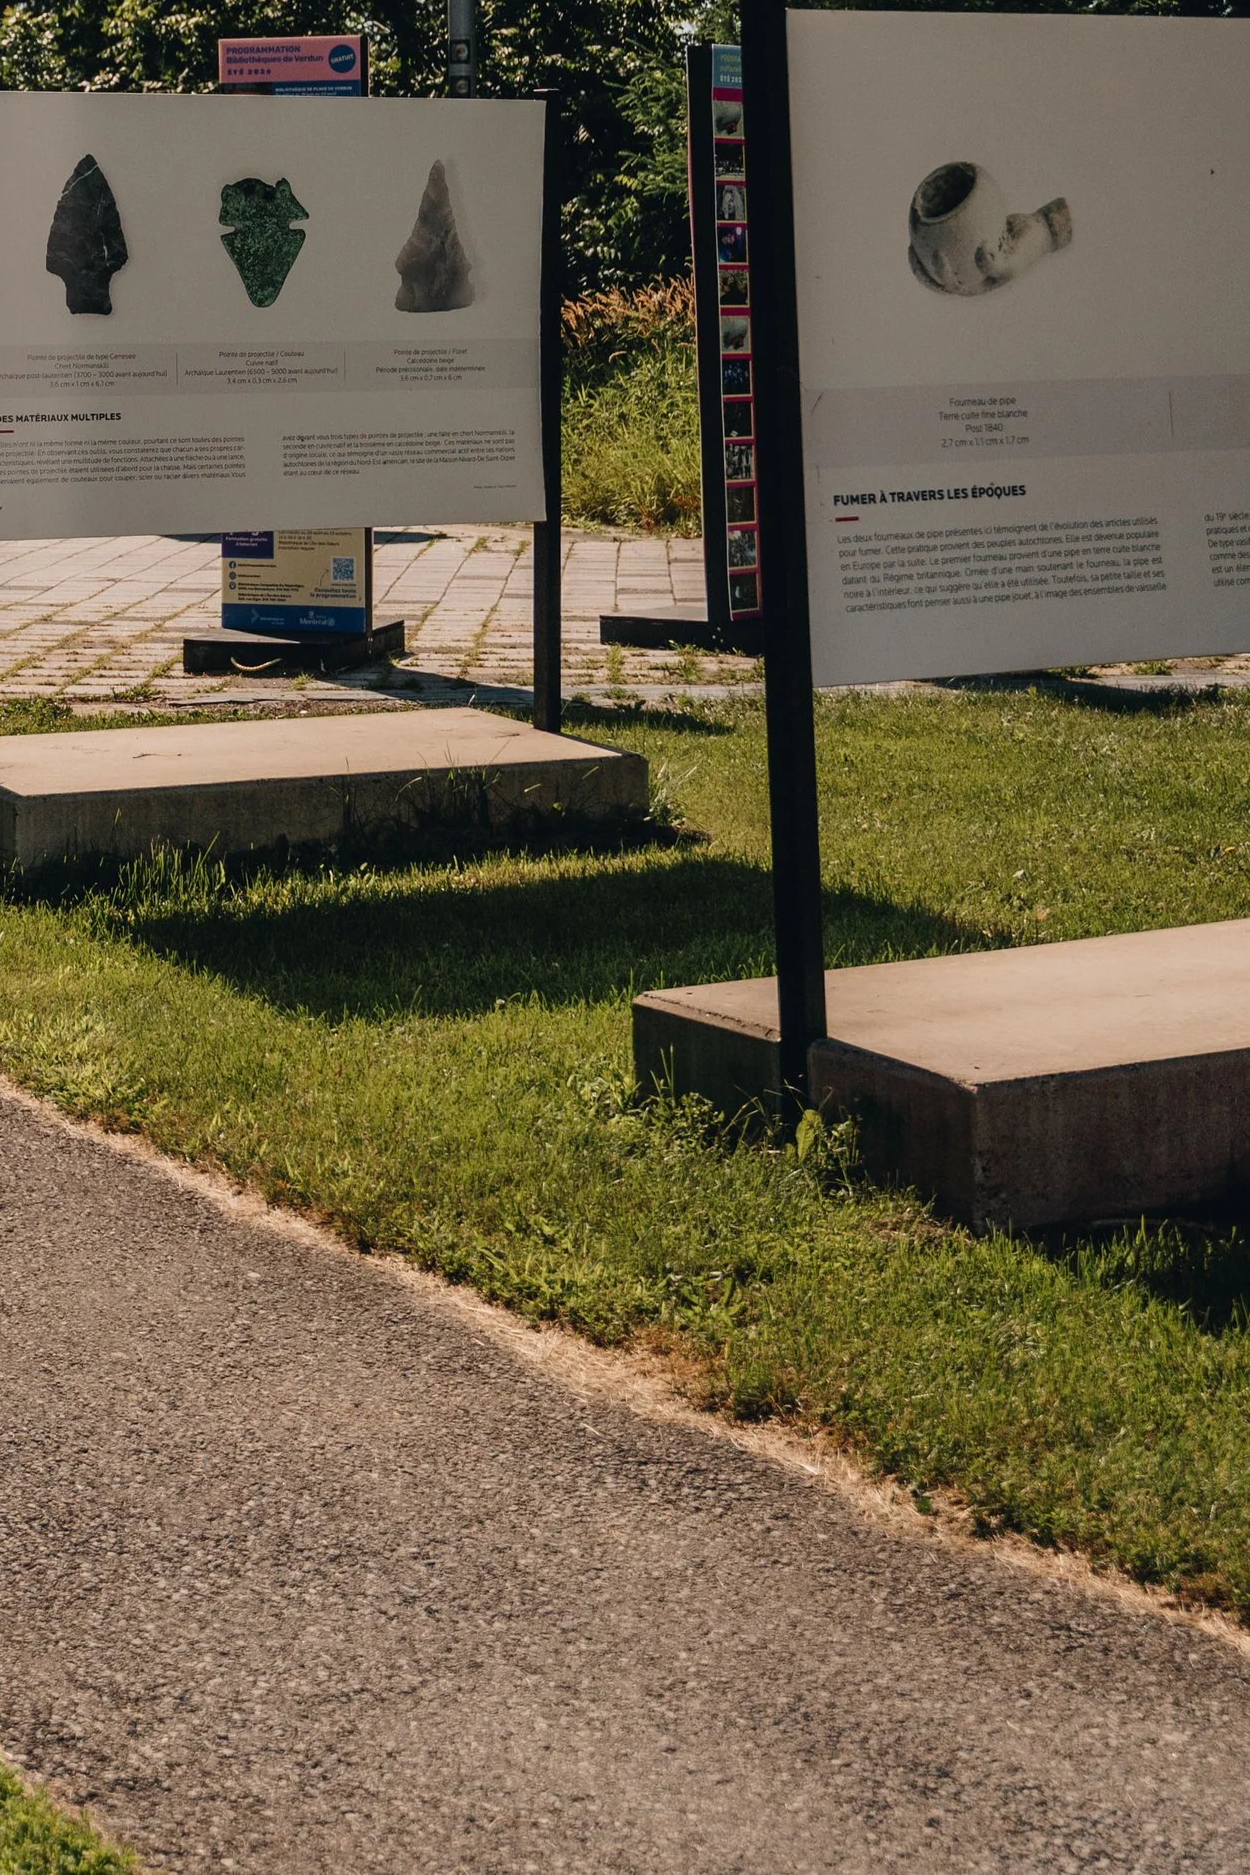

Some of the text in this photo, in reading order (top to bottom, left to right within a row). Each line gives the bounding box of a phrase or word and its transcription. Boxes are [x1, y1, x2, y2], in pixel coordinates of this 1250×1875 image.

[226, 45, 301, 55] PROGRAMMATION
[226, 54, 324, 64] Bibliothèques de Verdun
[330, 53, 354, 64] GRATUIT
[949, 397, 1016, 407] Fourneau de pipe
[16, 413, 69, 422] MATÉRIAUX
[71, 412, 122, 422] MULTIPLES
[938, 409, 1028, 421] Terre cuite fine blanche
[965, 423, 1003, 433] Post 1840
[954, 439, 966, 447] cm
[985, 438, 998, 446] cm
[1017, 437, 1029, 445] cm
[833, 493, 876, 507] FUMER
[879, 490, 887, 503] À
[889, 489, 944, 503] TRAVERS
[947, 487, 968, 499] LES
[836, 533, 852, 544] Les
[852, 532, 872, 543] deux
[874, 530, 914, 541] fourneaux
[914, 529, 925, 539] de
[926, 528, 944, 540] pipe
[984, 525, 992, 535] ici
[994, 522, 1037, 536] témoignent
[1038, 522, 1048, 531] de
[1090, 518, 1104, 528] des
[1104, 517, 1132, 527] articles
[1132, 515, 1158, 526] utilisés
[838, 528, 1160, 559] pour fumer. Cette pratique provient des peuples autochtones. Elle est devenue populaire
[840, 563, 850, 571] en
[852, 559, 882, 572] Europe
[882, 560, 896, 570] par
[897, 558, 906, 567] la
[906, 556, 928, 567] suite.
[928, 555, 940, 565] Le
[940, 553, 971, 566] premier
[972, 551, 1008, 563] fourneau
[1008, 549, 1040, 562] provient
[1063, 546, 1080, 559] pipe
[1081, 548, 1092, 556] en
[1092, 544, 1110, 555] terre
[1112, 543, 1130, 554] cuite
[1131, 541, 1162, 552] blanche
[842, 574, 866, 585] datant
[870, 573, 880, 583] du
[882, 571, 914, 584] Régime
[916, 568, 962, 582] britannique.
[964, 566, 989, 577] Ornée
[1014, 563, 1034, 573] main
[1036, 560, 1074, 572] soutenant
[1076, 559, 1084, 569] le
[1086, 557, 1121, 570] fourneau,
[1122, 556, 1131, 566] la
[1132, 555, 1150, 567] pipe
[1152, 554, 1163, 564] est
